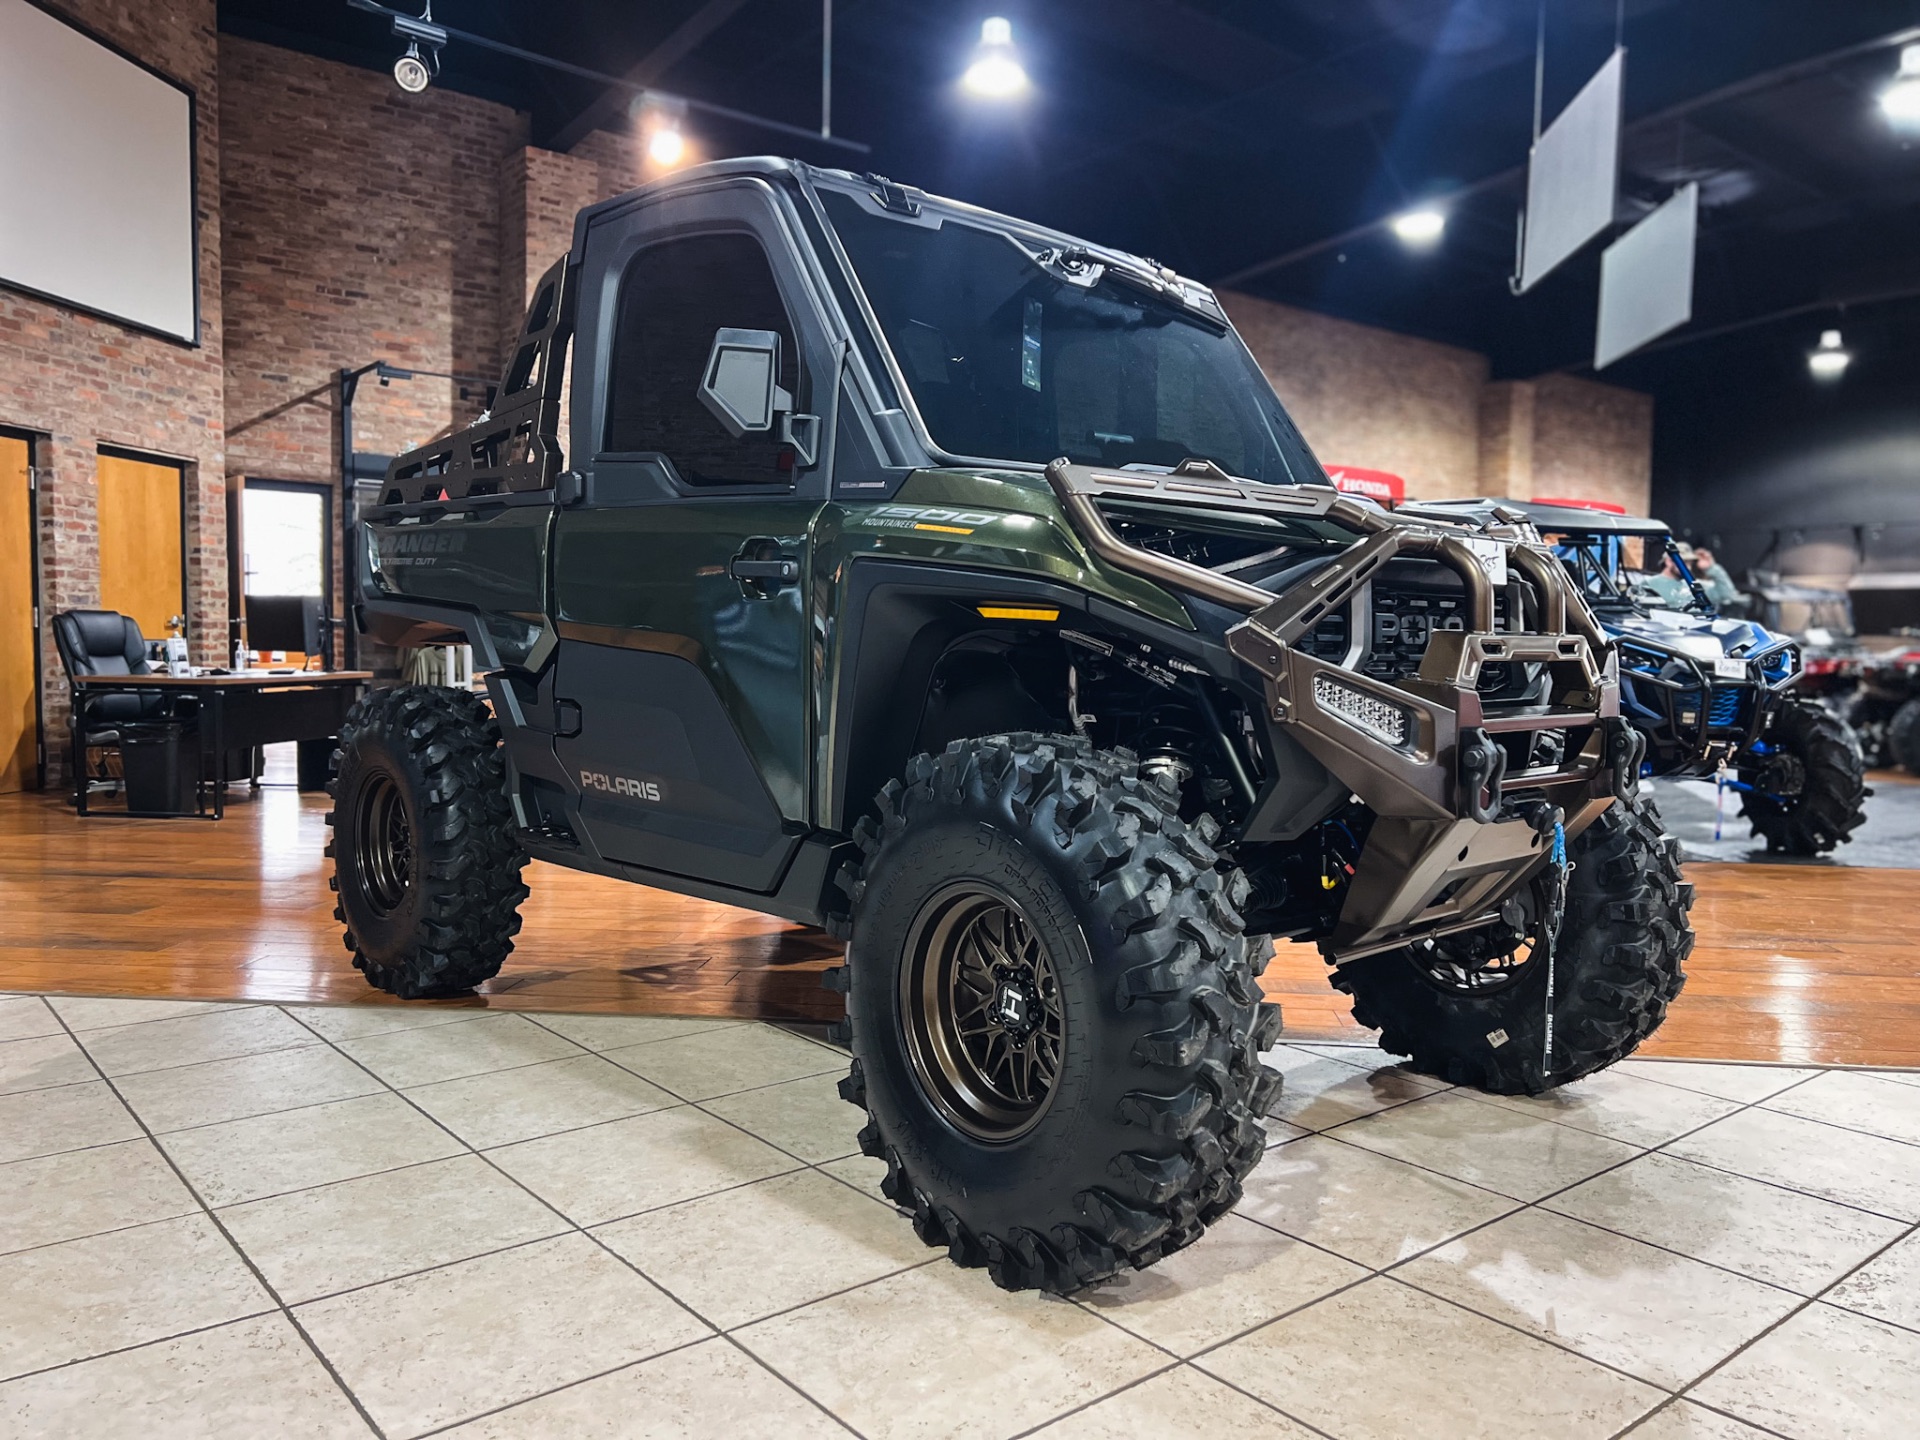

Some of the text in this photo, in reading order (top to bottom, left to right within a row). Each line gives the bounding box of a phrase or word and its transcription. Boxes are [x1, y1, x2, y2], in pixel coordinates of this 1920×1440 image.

[1342, 478, 1391, 497] HONDA
[861, 517, 918, 530] MOUNTAINEER
[868, 506, 998, 526] 1500
[381, 532, 465, 553] RANGER
[415, 557, 438, 566] DUTY
[580, 770, 661, 802] POLARIS
